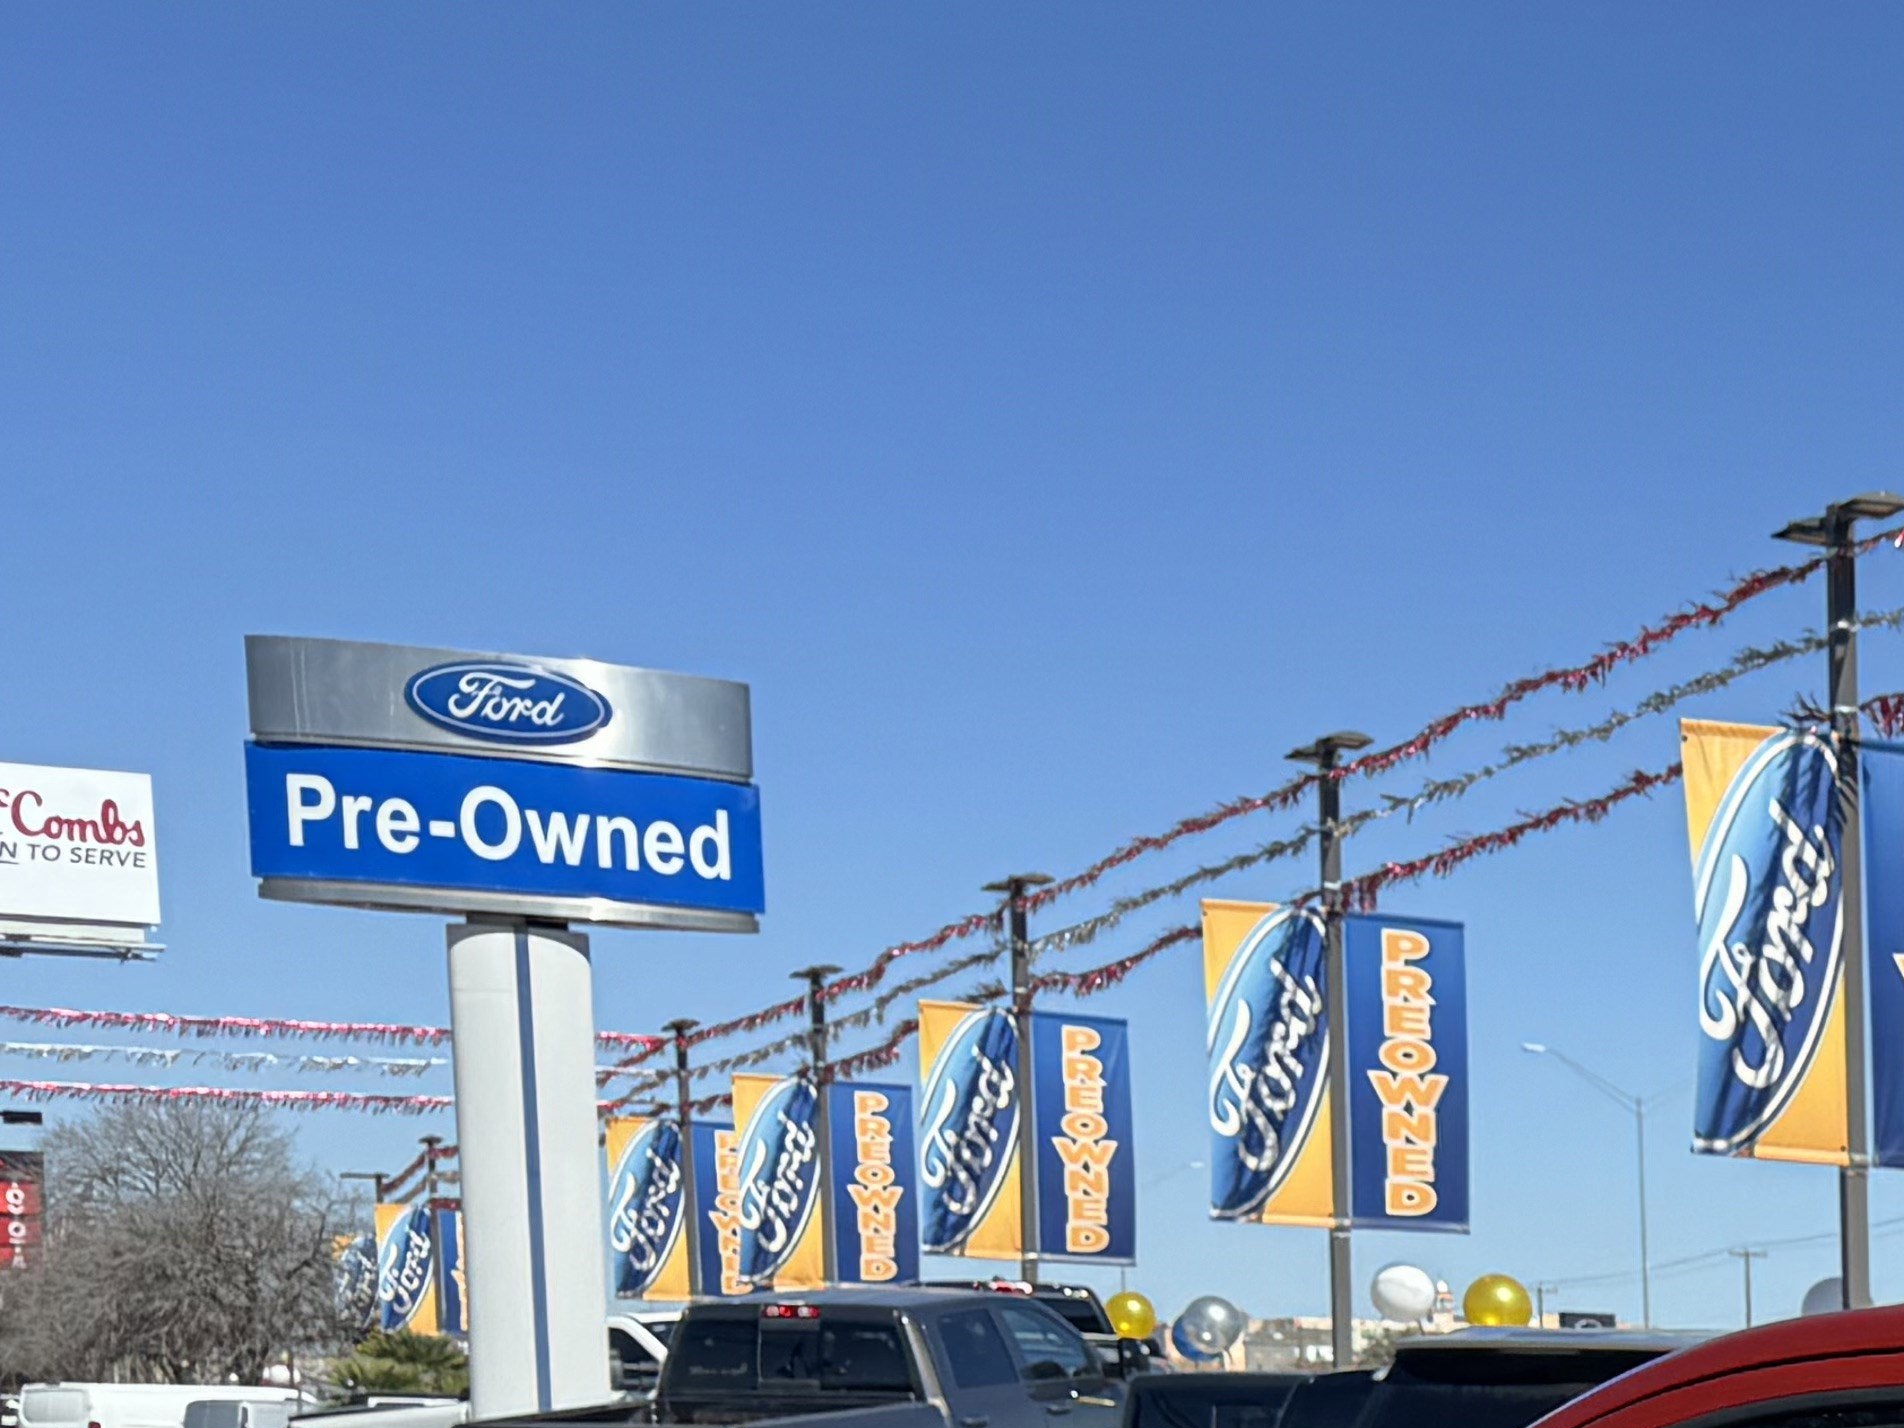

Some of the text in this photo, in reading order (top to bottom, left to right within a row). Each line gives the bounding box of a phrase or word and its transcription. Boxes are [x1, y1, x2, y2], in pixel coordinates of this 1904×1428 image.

[448, 670, 566, 728] Ford
[27, 843, 61, 861] TO
[70, 847, 147, 868] SERVE
[285, 773, 732, 881] Pre-Owned
[1700, 797, 1836, 1088] Ford
[921, 1044, 1015, 1215] Ford
[1052, 1024, 1118, 1253] PREOWNED
[1209, 957, 1321, 1172] Ford
[1367, 928, 1449, 1216] PREOWNED
[611, 1147, 681, 1271] Ford
[741, 1110, 815, 1252] Ford
[847, 1090, 904, 1281] PREOWNED
[379, 1229, 431, 1314] Ford
